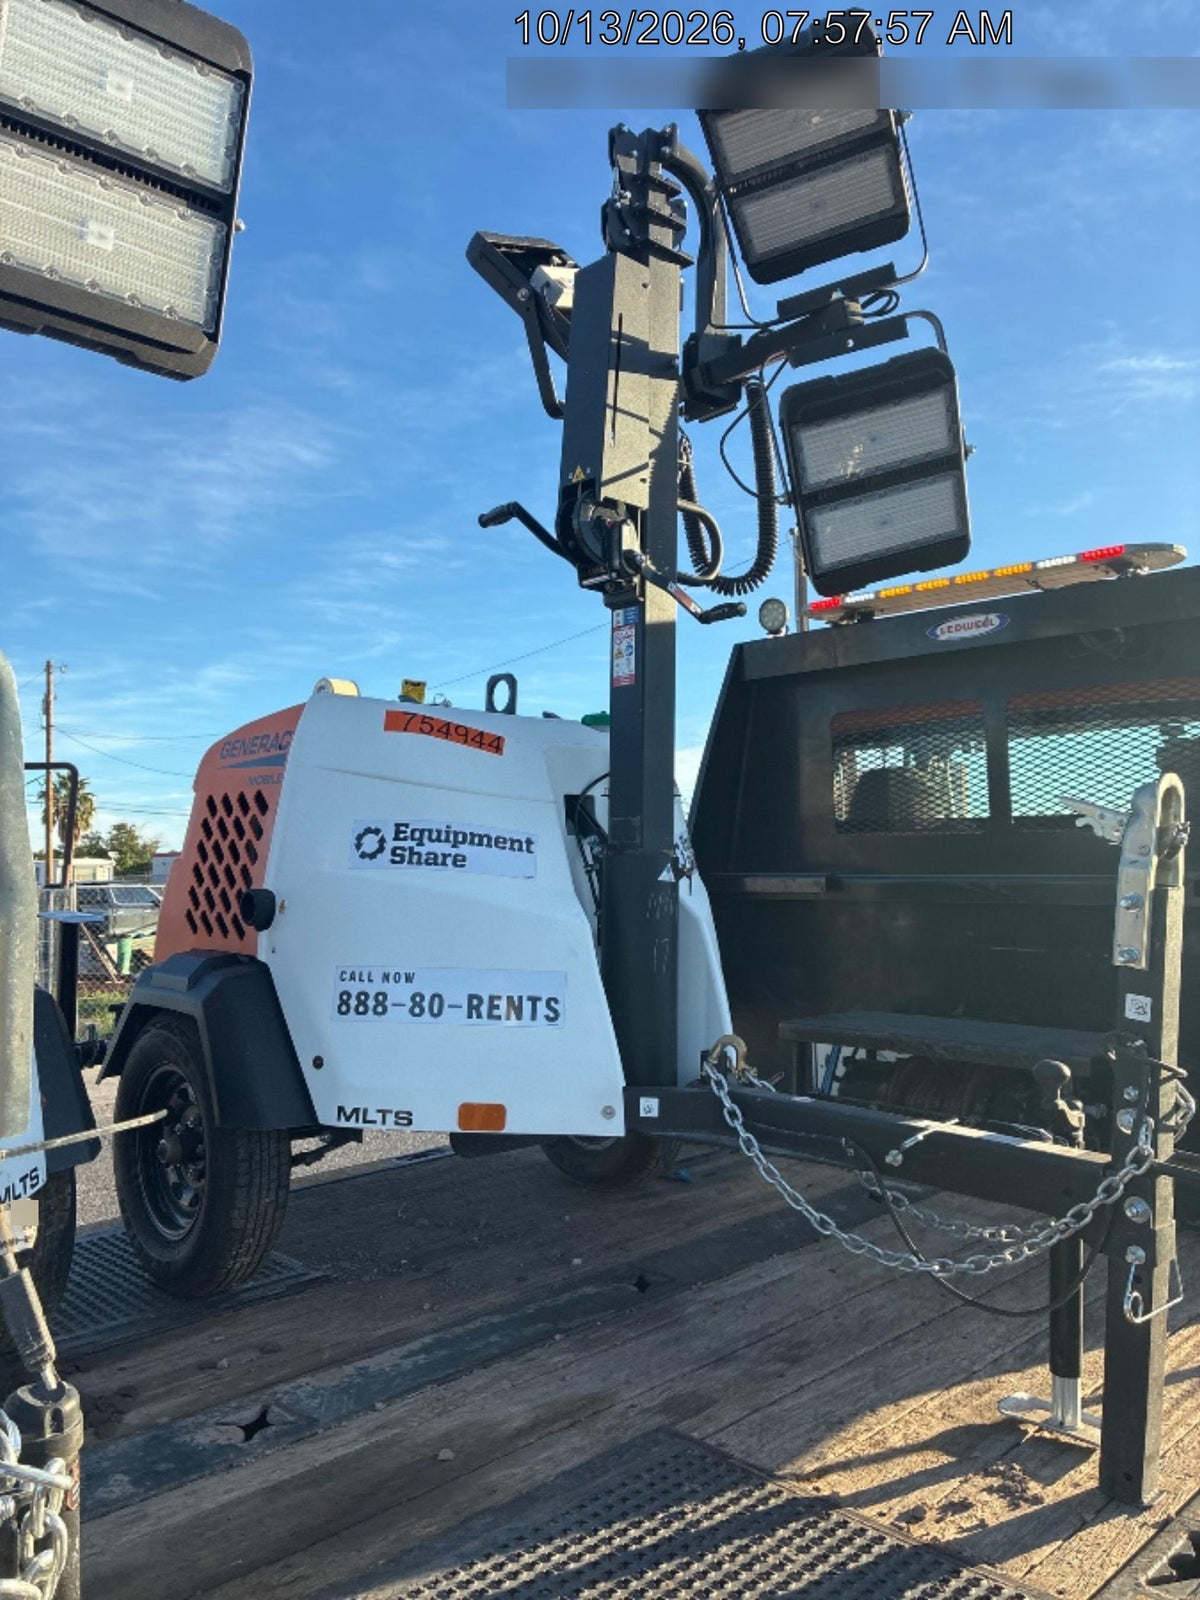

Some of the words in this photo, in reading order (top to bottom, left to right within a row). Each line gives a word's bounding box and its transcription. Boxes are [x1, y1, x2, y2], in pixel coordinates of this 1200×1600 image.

[220, 730, 295, 760] GENERAC
[403, 711, 503, 755] 754944
[392, 822, 535, 854] Equipment
[390, 845, 467, 868] Share
[339, 969, 375, 984] CALL
[381, 971, 416, 984] NOW
[336, 989, 561, 1023] 888-80-RENTS
[336, 1104, 413, 1127] MLTS
